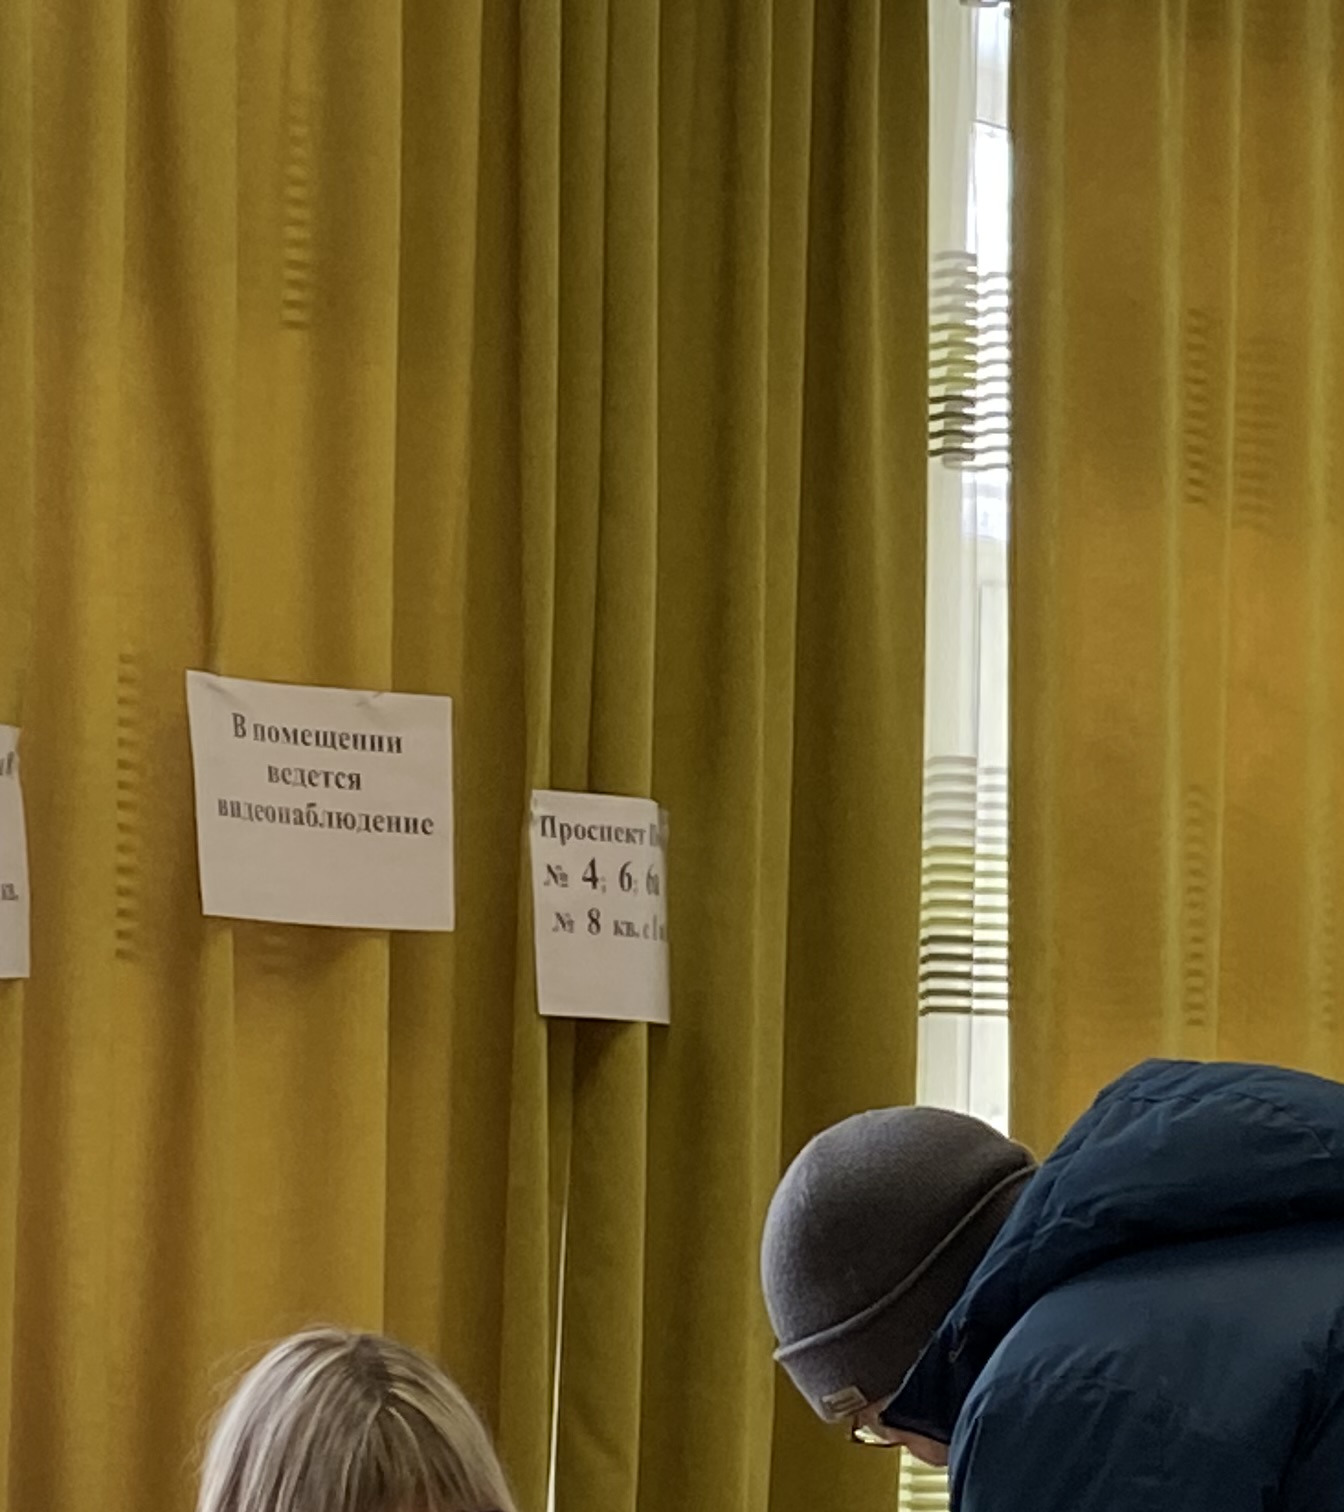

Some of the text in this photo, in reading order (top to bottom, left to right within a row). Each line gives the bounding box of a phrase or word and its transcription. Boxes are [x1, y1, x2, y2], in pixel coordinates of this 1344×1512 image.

[232, 712, 403, 754] В помещении
[267, 764, 362, 791] ведется
[217, 798, 434, 836] видеонаблюдение
[540, 815, 647, 846] Проспект
[543, 863, 569, 888] №
[552, 911, 575, 933] №
[587, 907, 601, 935] 8
